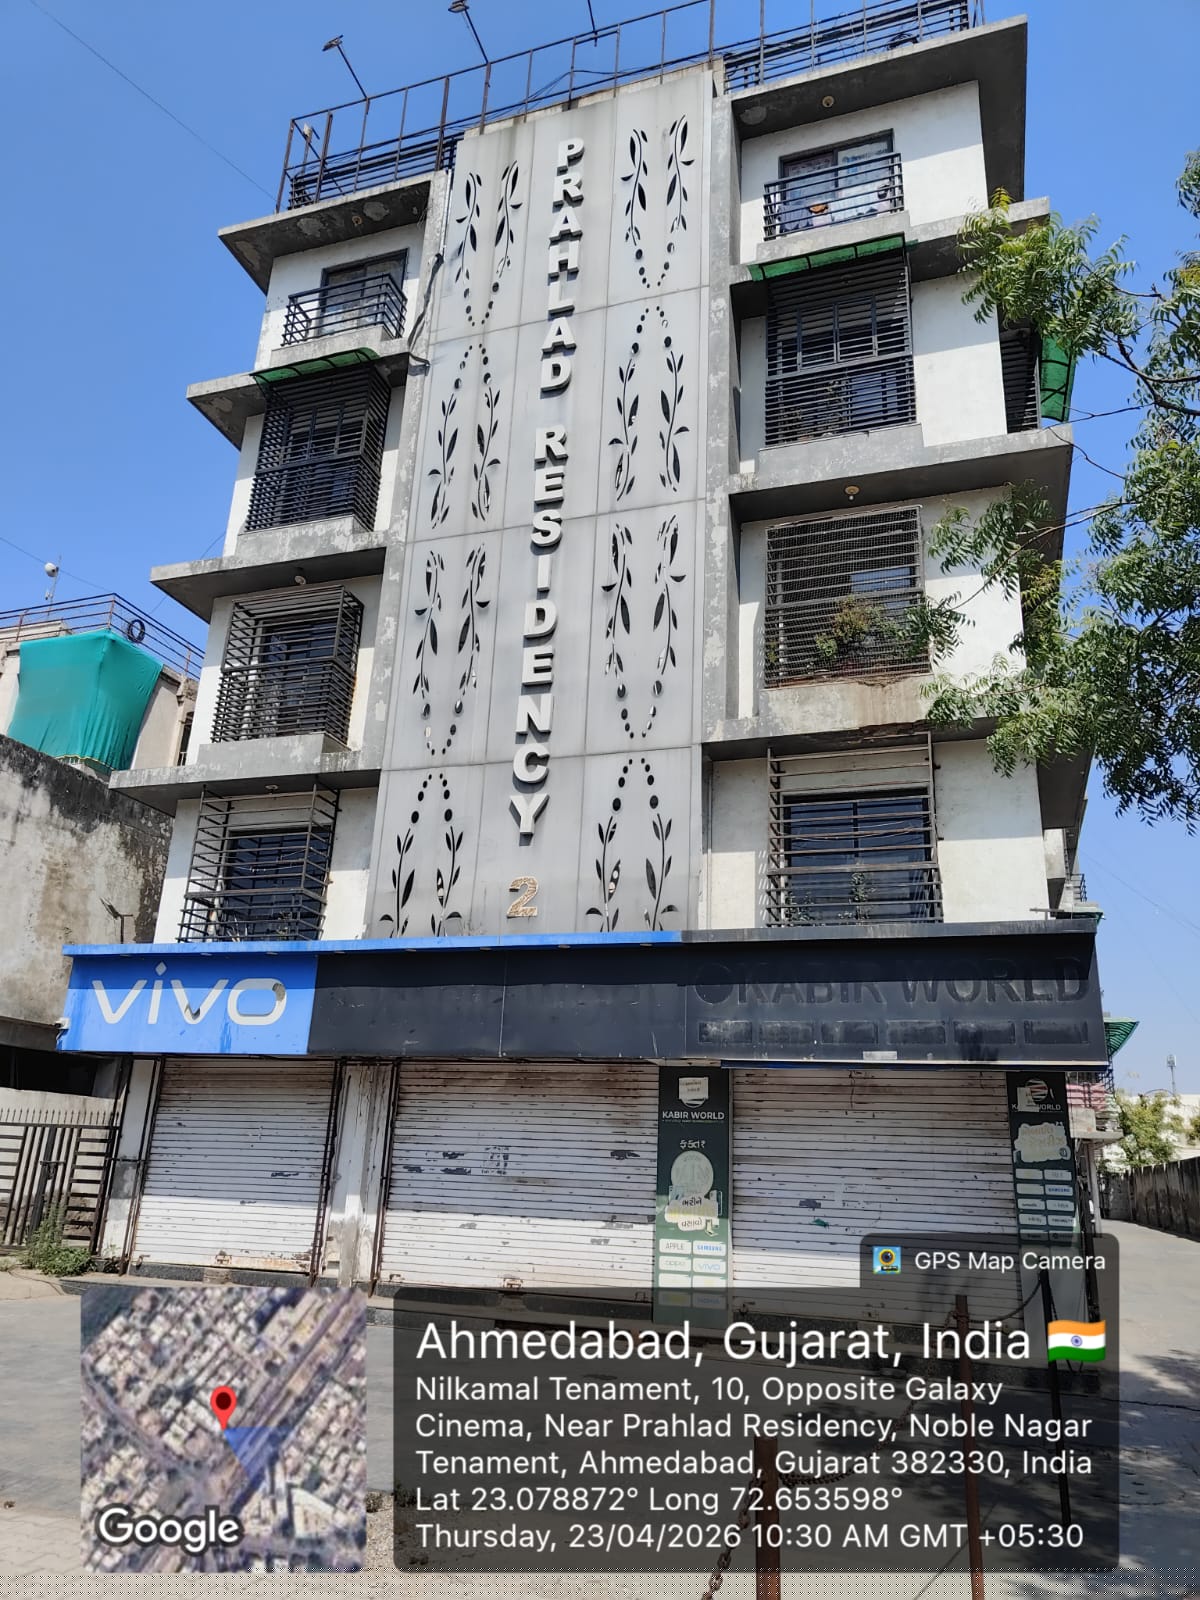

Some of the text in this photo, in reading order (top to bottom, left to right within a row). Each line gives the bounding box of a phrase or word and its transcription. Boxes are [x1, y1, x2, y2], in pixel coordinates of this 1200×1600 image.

[506, 137, 585, 918] PRAHLAD RESIDENCY 2
[92, 961, 287, 1026] vivo
[897, 955, 1090, 1004] WORLD
[662, 1111, 725, 1120] KABIR WORLD
[665, 1242, 684, 1250] APPLE
